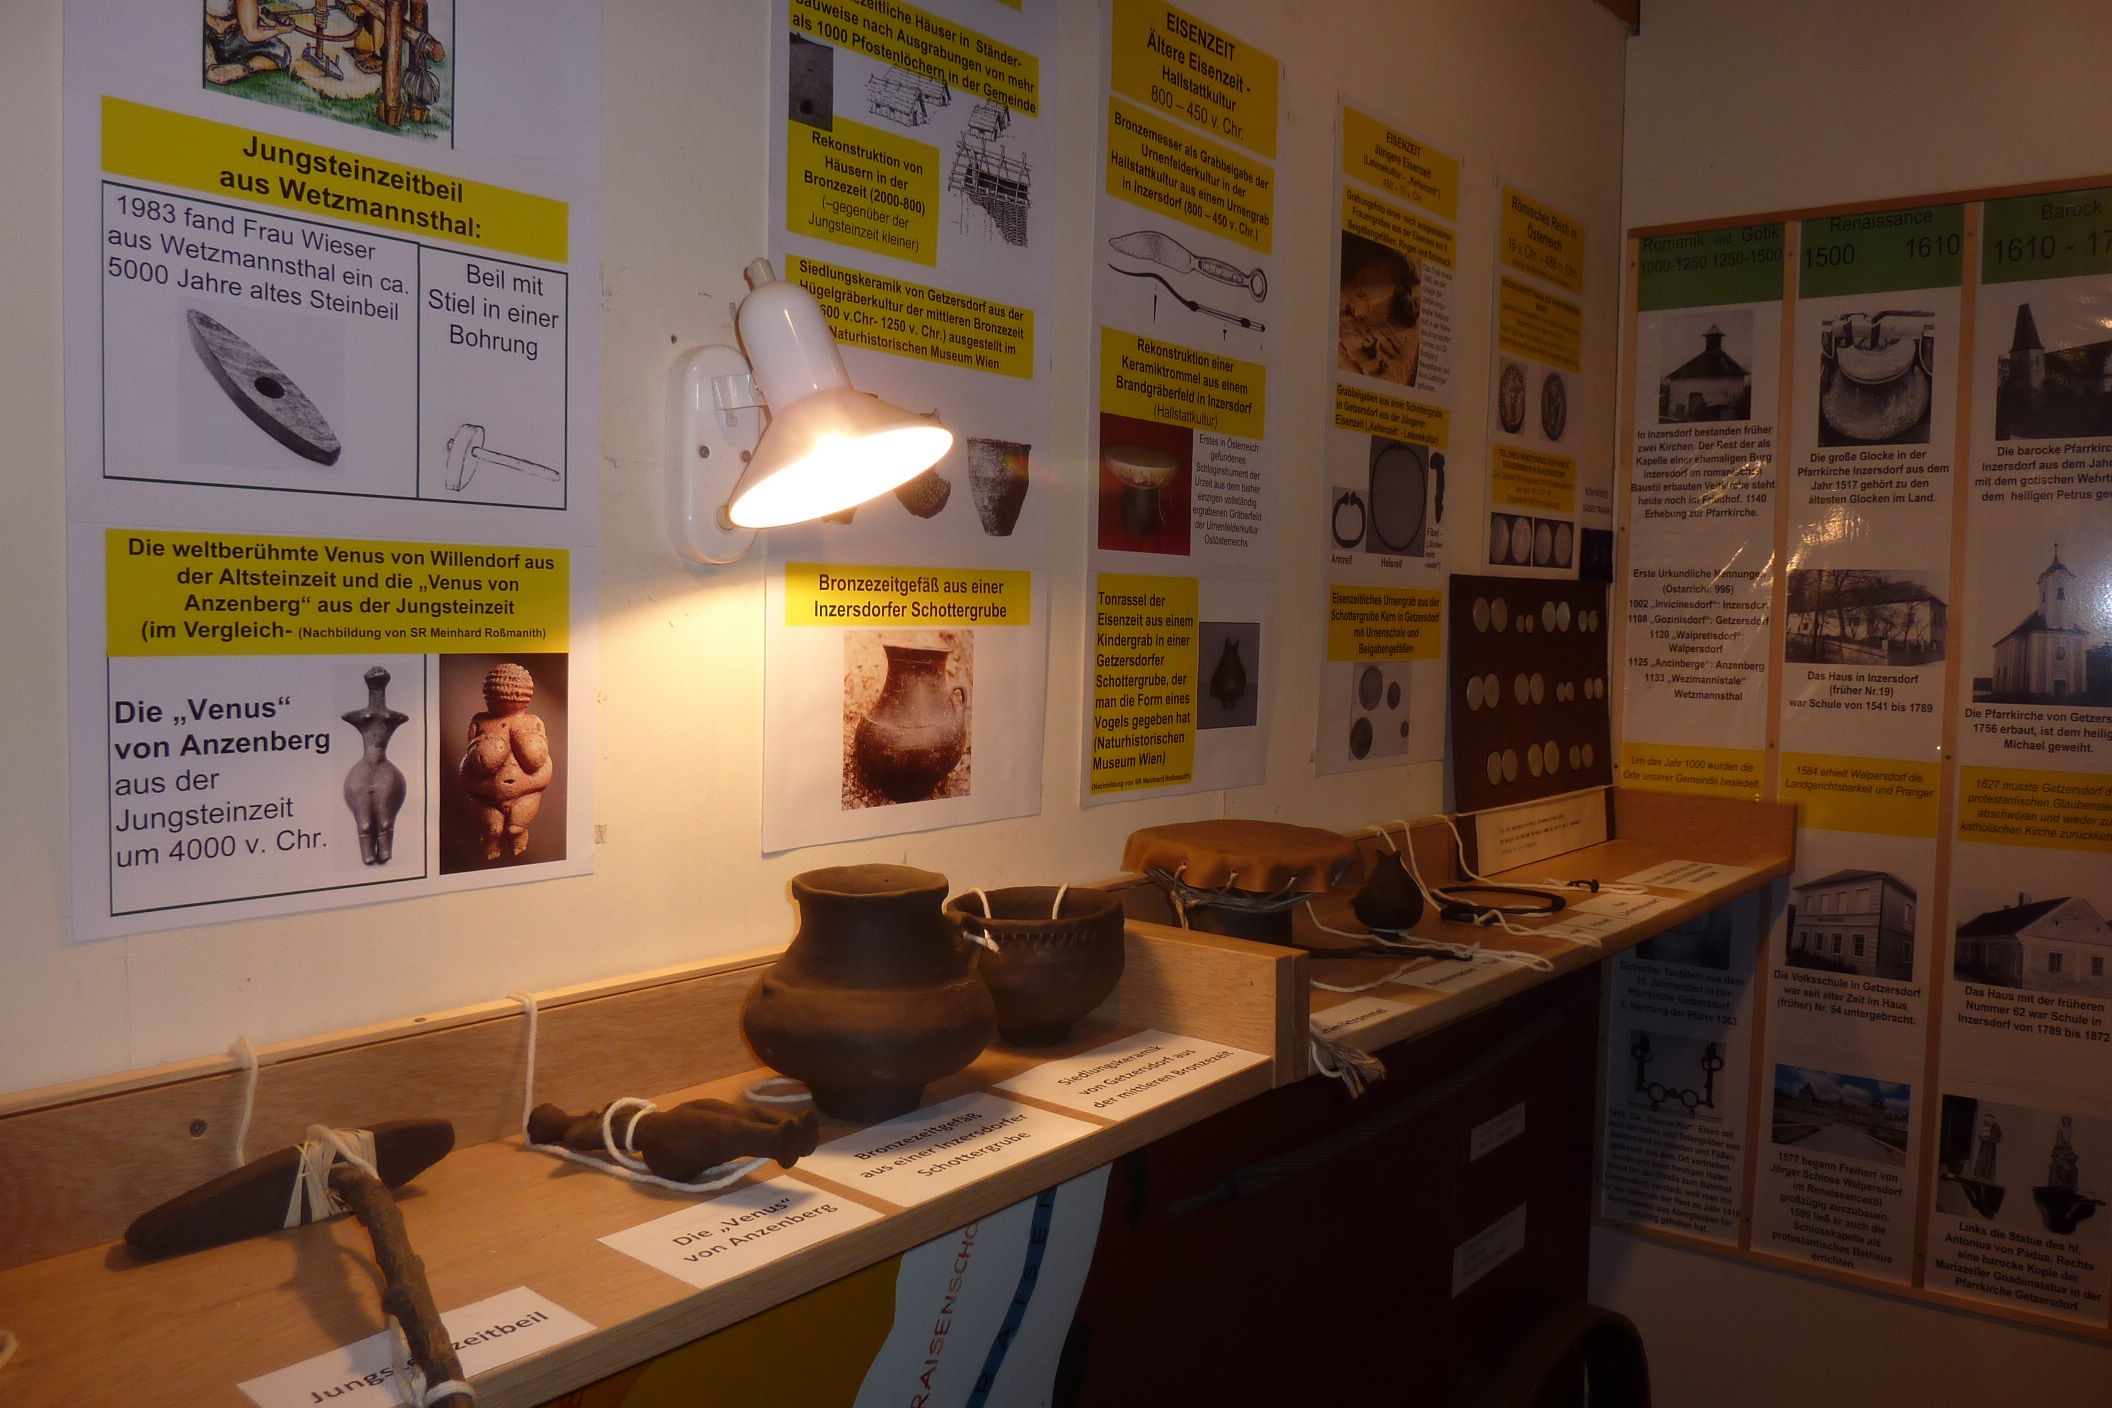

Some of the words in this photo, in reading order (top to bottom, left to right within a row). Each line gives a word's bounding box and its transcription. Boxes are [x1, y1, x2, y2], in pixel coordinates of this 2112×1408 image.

[1167, 13, 1236, 61] EISENZEIT
[1147, 29, 1185, 66] Ältere
[1188, 52, 1243, 93] Eisenzeit
[1162, 66, 1236, 112] Hallstattkultur
[812, 132, 900, 168] Rekonstruktion
[902, 160, 923, 175] von
[243, 137, 463, 204] Jungsteinzeitbeil
[824, 156, 872, 181] Häusern
[876, 170, 886, 185] in
[889, 173, 908, 190] der
[219, 171, 269, 197] aus
[278, 177, 481, 238] Wetzmannsthal:
[804, 171, 866, 199] Bronzezeit
[869, 187, 925, 216] (2000-800)
[1830, 213, 1934, 233] Renaissance
[2041, 201, 2102, 221] Barock
[118, 194, 175, 225] 1983
[183, 206, 234, 235] fand
[242, 216, 293, 246] Frau
[301, 227, 375, 260] Wieser
[808, 212, 878, 241] Jungsteinzeit
[881, 229, 919, 253] kleiner)
[1805, 244, 1855, 269] 1500
[1906, 234, 1960, 259] 1610
[1993, 236, 2056, 264] 1610
[108, 230, 151, 253] aus
[159, 234, 335, 283] Wetzmannsthal
[342, 266, 372, 289] ein
[379, 275, 409, 295] ca.
[108, 257, 168, 286] 5000
[176, 267, 242, 297] Jahre
[249, 280, 301, 306] altes
[309, 287, 399, 320] Steinbeil
[467, 265, 504, 289] Beil
[512, 275, 543, 296] mit
[428, 289, 475, 316] Stiel
[483, 298, 500, 320] in
[507, 303, 559, 329] einer
[450, 325, 538, 360] Bohrung
[1137, 339, 1209, 368] Rekonstruktion
[1211, 357, 1234, 373] einer
[1122, 356, 1200, 385] Keramiktrommel
[1202, 376, 1219, 389] aus
[1221, 378, 1248, 395] einem
[1116, 376, 1194, 404] Brandgräberfeld
[1196, 392, 1205, 406] in
[1207, 394, 1252, 415] Inzersdorf
[1797, 467, 1850, 477] Pfarrkirche
[1852, 465, 1903, 475] Inzersdorf
[1926, 465, 1949, 474] dem
[1810, 454, 1825, 463] Die
[1828, 453, 1856, 465] große
[1859, 451, 1894, 461] Glocke
[1896, 451, 1906, 460] in
[1908, 450, 1927, 460] der
[1808, 496, 1847, 505] ältesten
[1849, 494, 1890, 504] Glocken
[1892, 494, 1905, 503] im
[1811, 481, 1832, 490] Jahr
[1835, 481, 1857, 490] 1517
[1860, 480, 1892, 491] gehört
[1909, 479, 1929, 488] den
[128, 538, 165, 557] Die
[171, 541, 318, 562] weltberühmte
[324, 545, 384, 565] Venus
[390, 551, 424, 566] von
[429, 549, 520, 569] Willendorf
[524, 556, 554, 570] aus
[177, 567, 213, 585] der
[218, 568, 336, 588] Altsteinzeit
[342, 572, 378, 589] und
[384, 572, 412, 590] die
[418, 573, 482, 593] „Venus
[487, 578, 519, 592] von
[819, 574, 939, 597] Bronzezeitgefäß
[943, 580, 967, 593] aus
[971, 577, 1004, 594] einer
[184, 595, 310, 617] Anzenberg“
[316, 601, 352, 613] aus
[359, 597, 390, 614] der
[395, 597, 514, 618] Jungsteinzeit
[814, 601, 907, 617] Inzersdorfer
[910, 601, 1007, 622] Schottergrube
[1099, 593, 1146, 606] Tonrassel
[1149, 594, 1165, 607] der
[141, 622, 176, 643] (im
[182, 622, 293, 643] Vergleich-
[298, 627, 381, 641] (Nachbildung
[384, 630, 406, 638] von
[409, 627, 426, 638] SR
[430, 627, 481, 638] Meinhard
[484, 627, 546, 641] Roßmanith)
[1098, 614, 1142, 626] Eisenzeit
[1145, 617, 1162, 627] aus
[1165, 615, 1193, 627] einem
[1097, 634, 1152, 649] Kindergrab
[1155, 634, 1164, 646] in
[1166, 634, 1190, 646] einer
[1096, 674, 1168, 690] Schottergrube,
[1171, 673, 1187, 686] der
[1807, 671, 1825, 681] Das
[1828, 672, 1852, 682] Haus
[1855, 673, 1864, 682] in
[1867, 673, 1919, 684] Inzersdorf
[115, 701, 162, 724] Die
[173, 696, 290, 727] „Venus“
[1789, 700, 1807, 708] war
[1808, 699, 1841, 709] Schule
[1844, 702, 1862, 710] von
[1866, 701, 1887, 711] 1541
[1890, 702, 1905, 712] bis
[1909, 703, 1933, 713] 1789
[115, 740, 169, 759] von
[178, 729, 330, 756] Anzenberg
[2004, 740, 2044, 751] Michael
[115, 777, 165, 796] aus
[175, 770, 219, 792] der
[115, 798, 293, 834] Jungsteinzeit
[116, 848, 159, 868] um
[168, 835, 235, 863] 4000
[244, 838, 265, 856] v.
[275, 828, 327, 852] Chr.
[1774, 970, 1788, 981] Die
[1791, 972, 1848, 988] Volksschule
[1850, 979, 1859, 990] in
[1861, 981, 1921, 998] Getzersdorf
[1964, 987, 1984, 998] Das
[1987, 989, 2014, 1001] Haus
[2016, 994, 2034, 1004] mit
[2036, 995, 2055, 1006] der
[2057, 998, 2104, 1012] früheren
[854, 1112, 983, 1160] Bronzezeitgefäß
[860, 1165, 894, 1178] aus
[894, 1149, 936, 1167] einer
[935, 1113, 1029, 1150] Inzersdorfer
[917, 1131, 1032, 1177] Schottergrube
[672, 1229, 713, 1247] Die
[721, 1197, 791, 1233] „Venus“
[683, 1244, 727, 1263] von
[729, 1203, 838, 1247] Anzenberg
